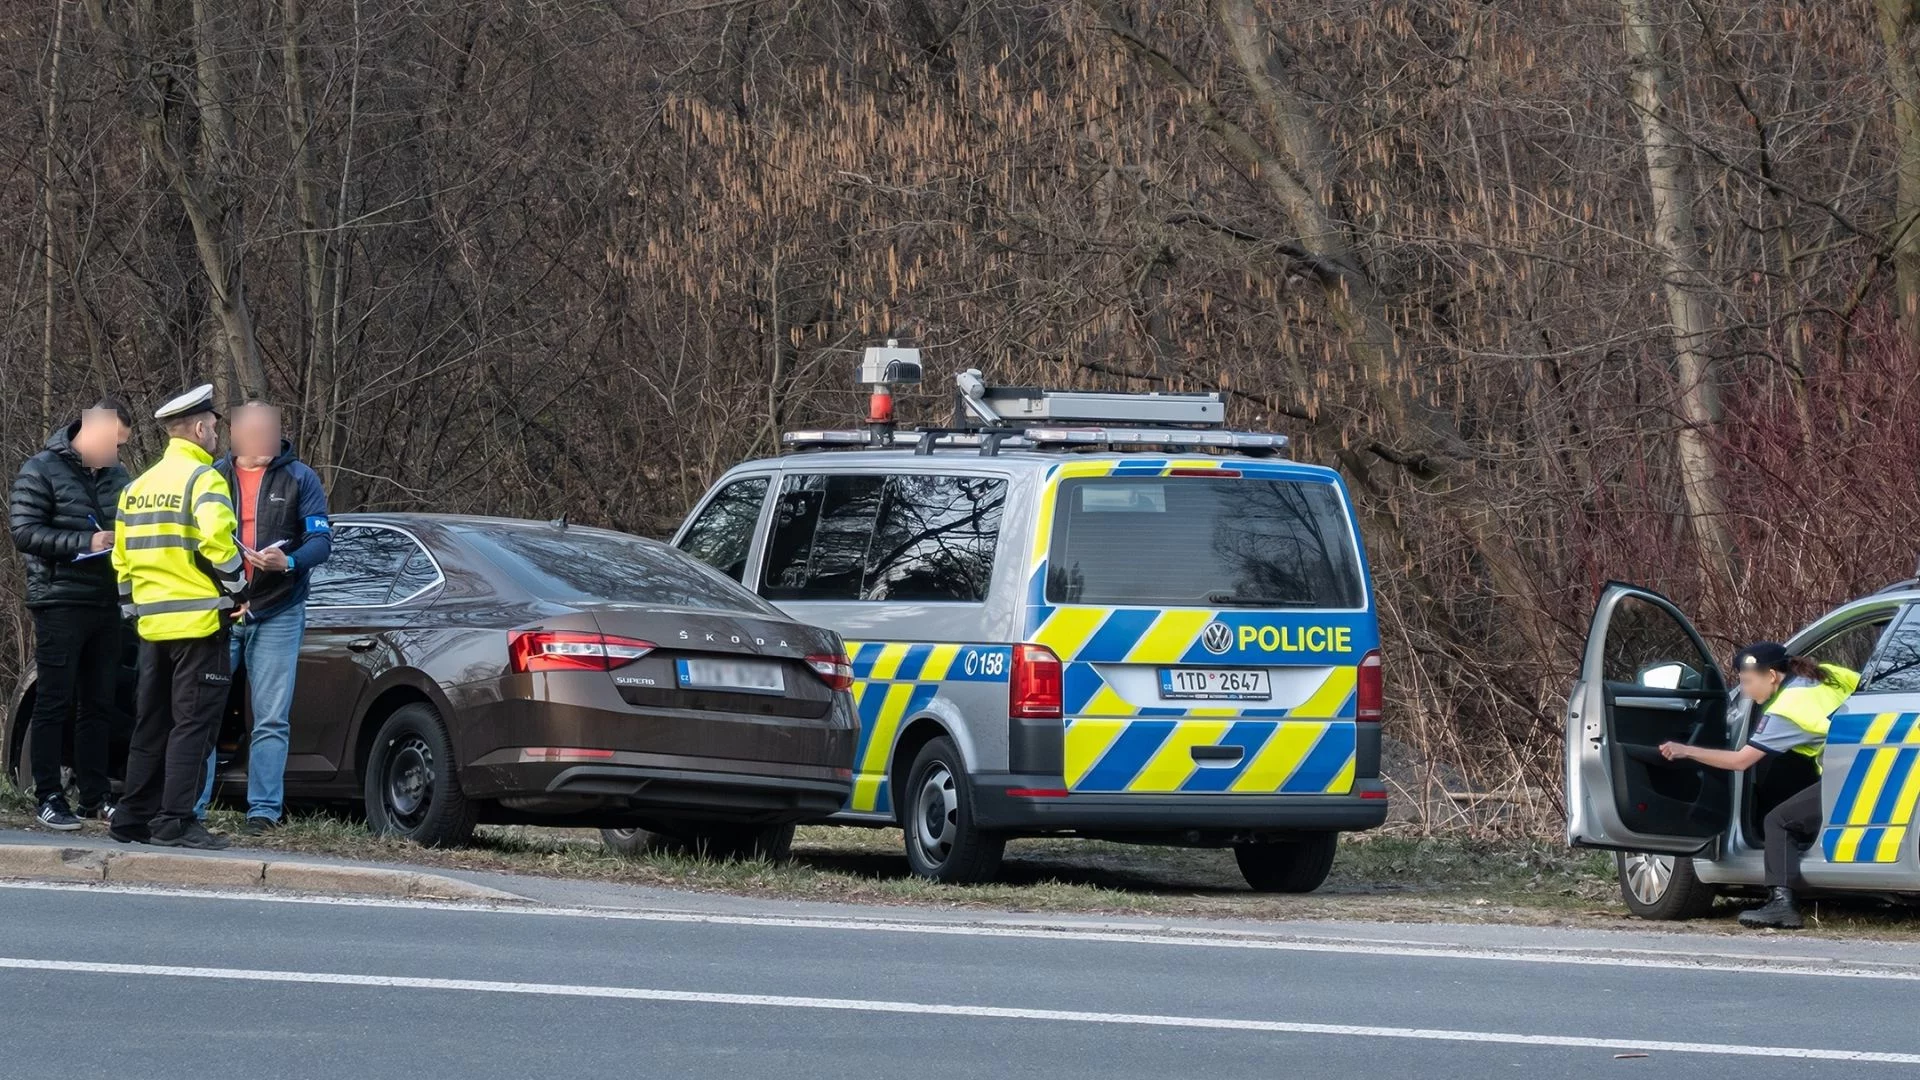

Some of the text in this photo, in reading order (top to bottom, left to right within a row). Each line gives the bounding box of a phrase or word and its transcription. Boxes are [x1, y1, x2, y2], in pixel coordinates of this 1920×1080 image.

[125, 494, 182, 510] POLICIE
[1238, 625, 1352, 652] POLICIE
[980, 652, 1004, 675] 158
[616, 676, 655, 686] SUPERB
[1176, 672, 1260, 691] 1TD 2647
